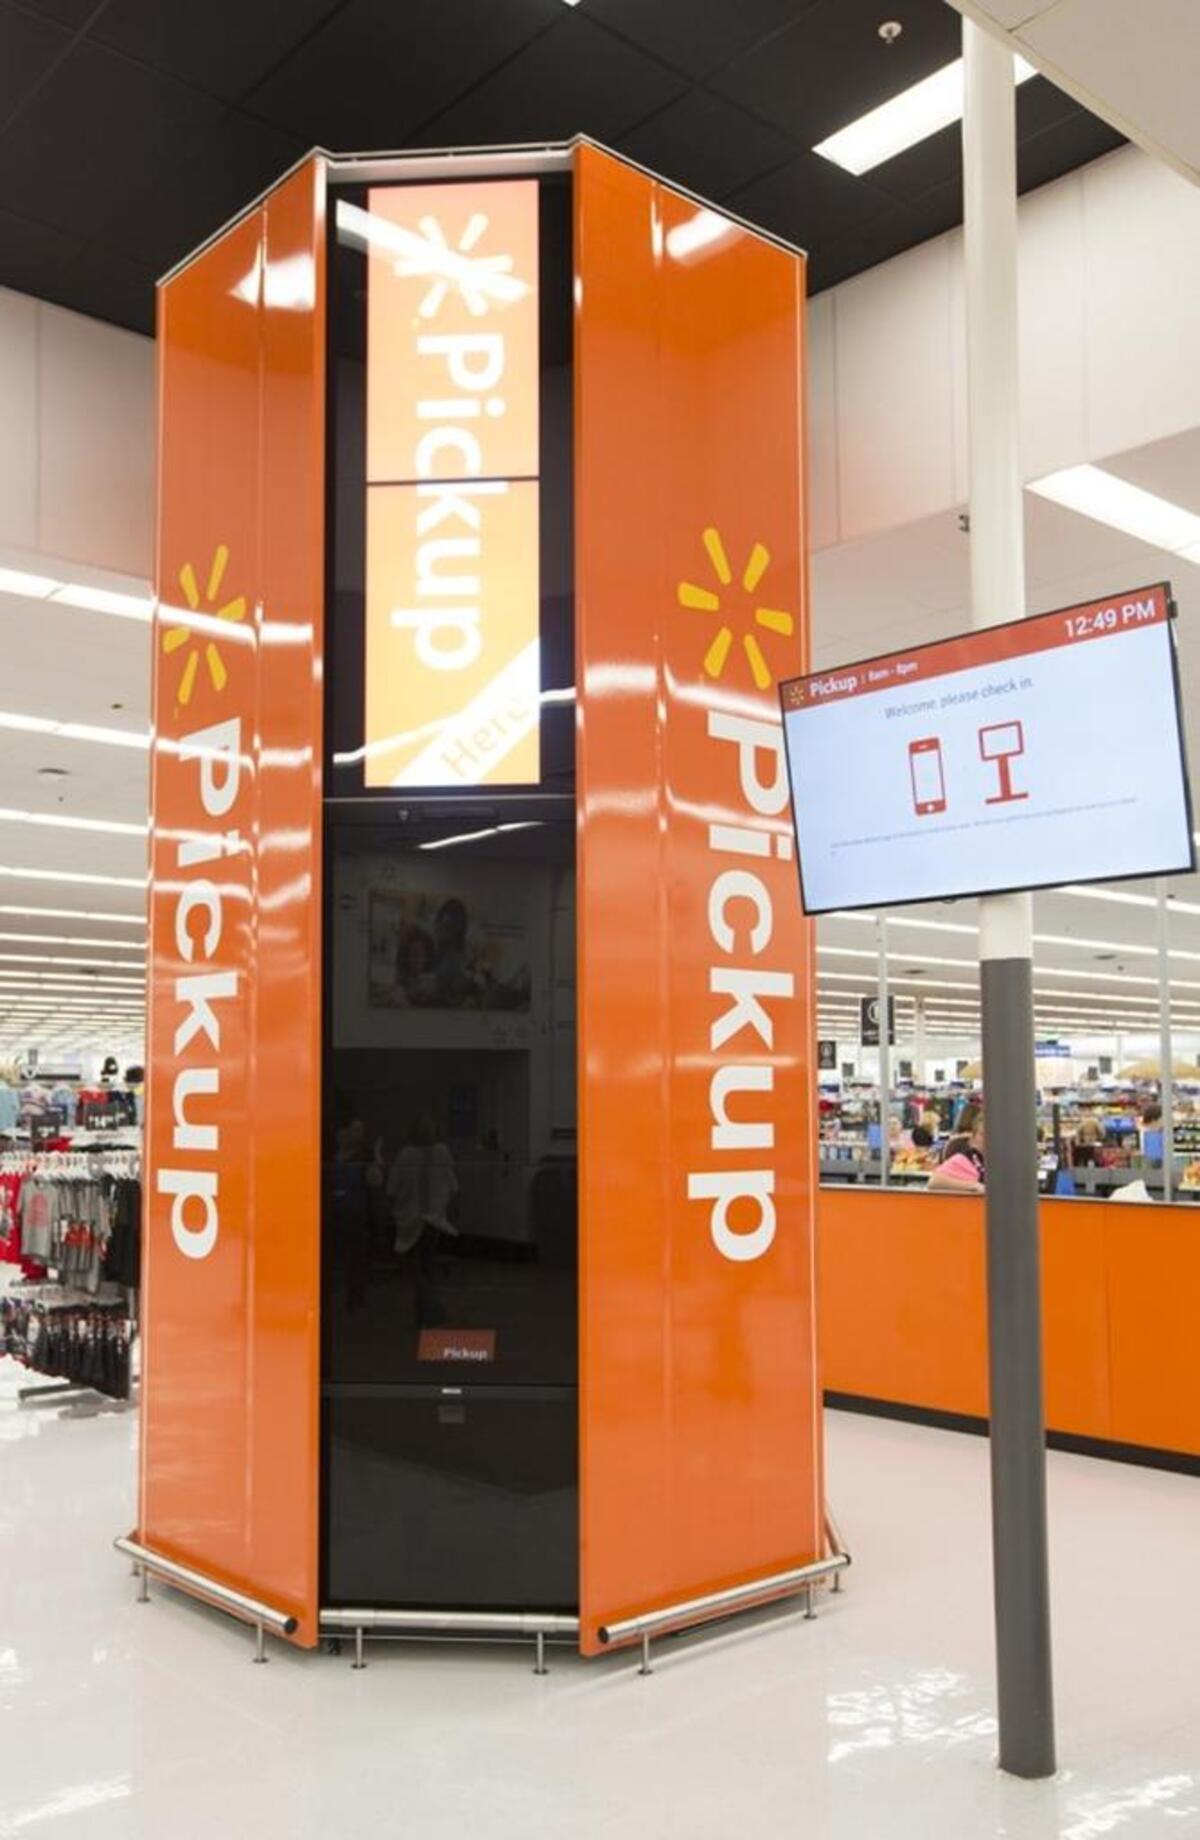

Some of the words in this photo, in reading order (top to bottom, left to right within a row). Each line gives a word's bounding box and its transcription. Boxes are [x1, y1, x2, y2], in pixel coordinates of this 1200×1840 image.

[390, 332, 509, 671] Pickup
[1064, 608, 1118, 638] 12:49
[1122, 598, 1156, 625] PM
[809, 676, 858, 697] Pickup
[939, 689, 980, 709] please
[980, 678, 1017, 698] check
[156, 716, 242, 1259] Pickup
[687, 709, 795, 1263] Pickup
[443, 1348, 489, 1362] Pickup
